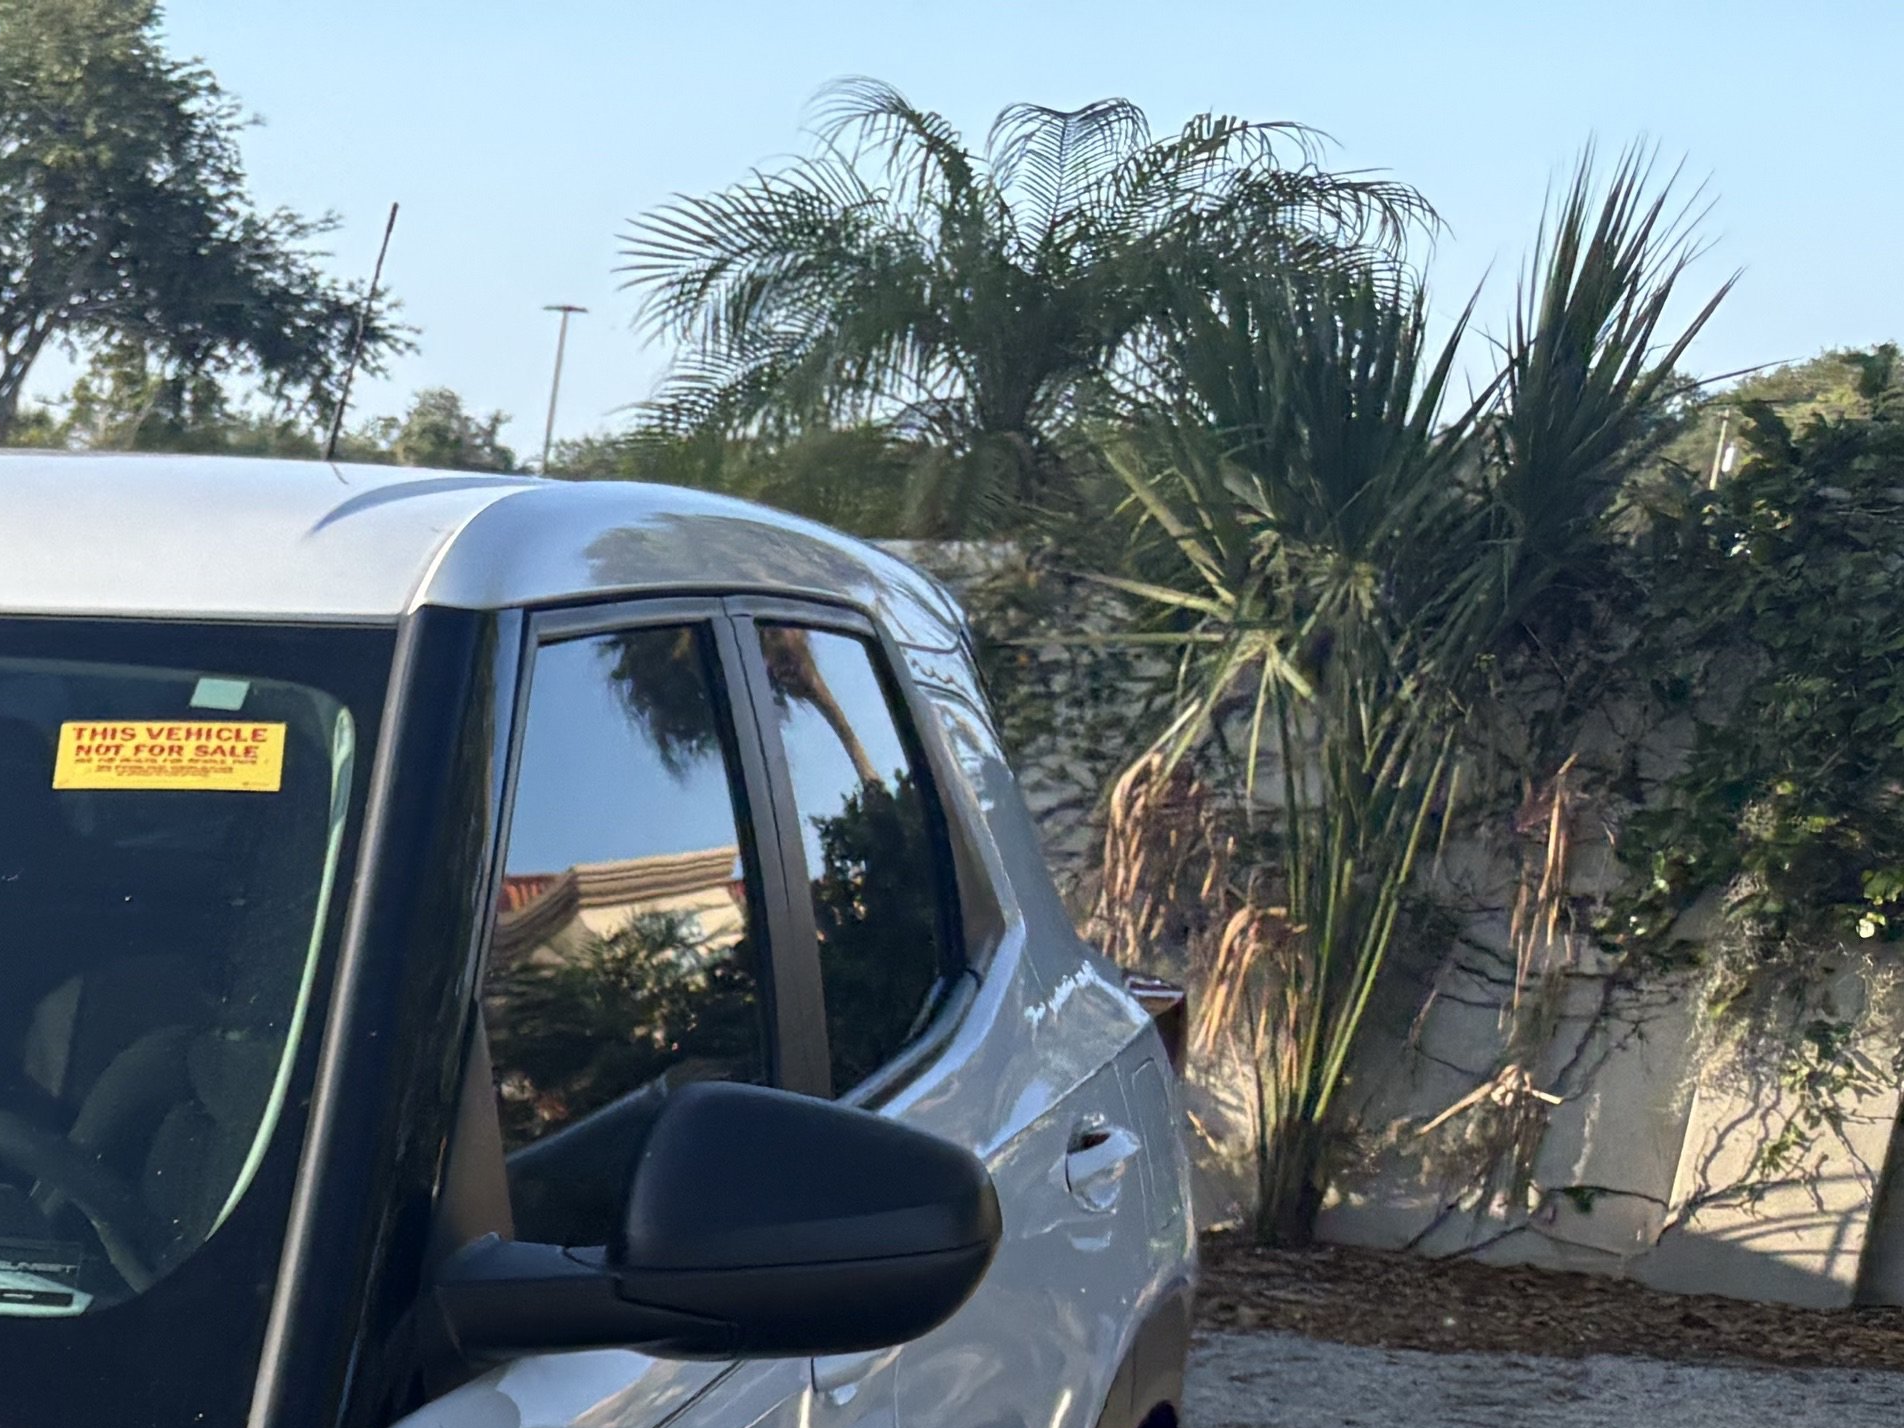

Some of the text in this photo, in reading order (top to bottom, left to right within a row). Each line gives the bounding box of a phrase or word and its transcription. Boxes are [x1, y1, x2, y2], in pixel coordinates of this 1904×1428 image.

[72, 727, 269, 742] THIS VEHICLE
[74, 744, 260, 759] NOT FOR SALE
